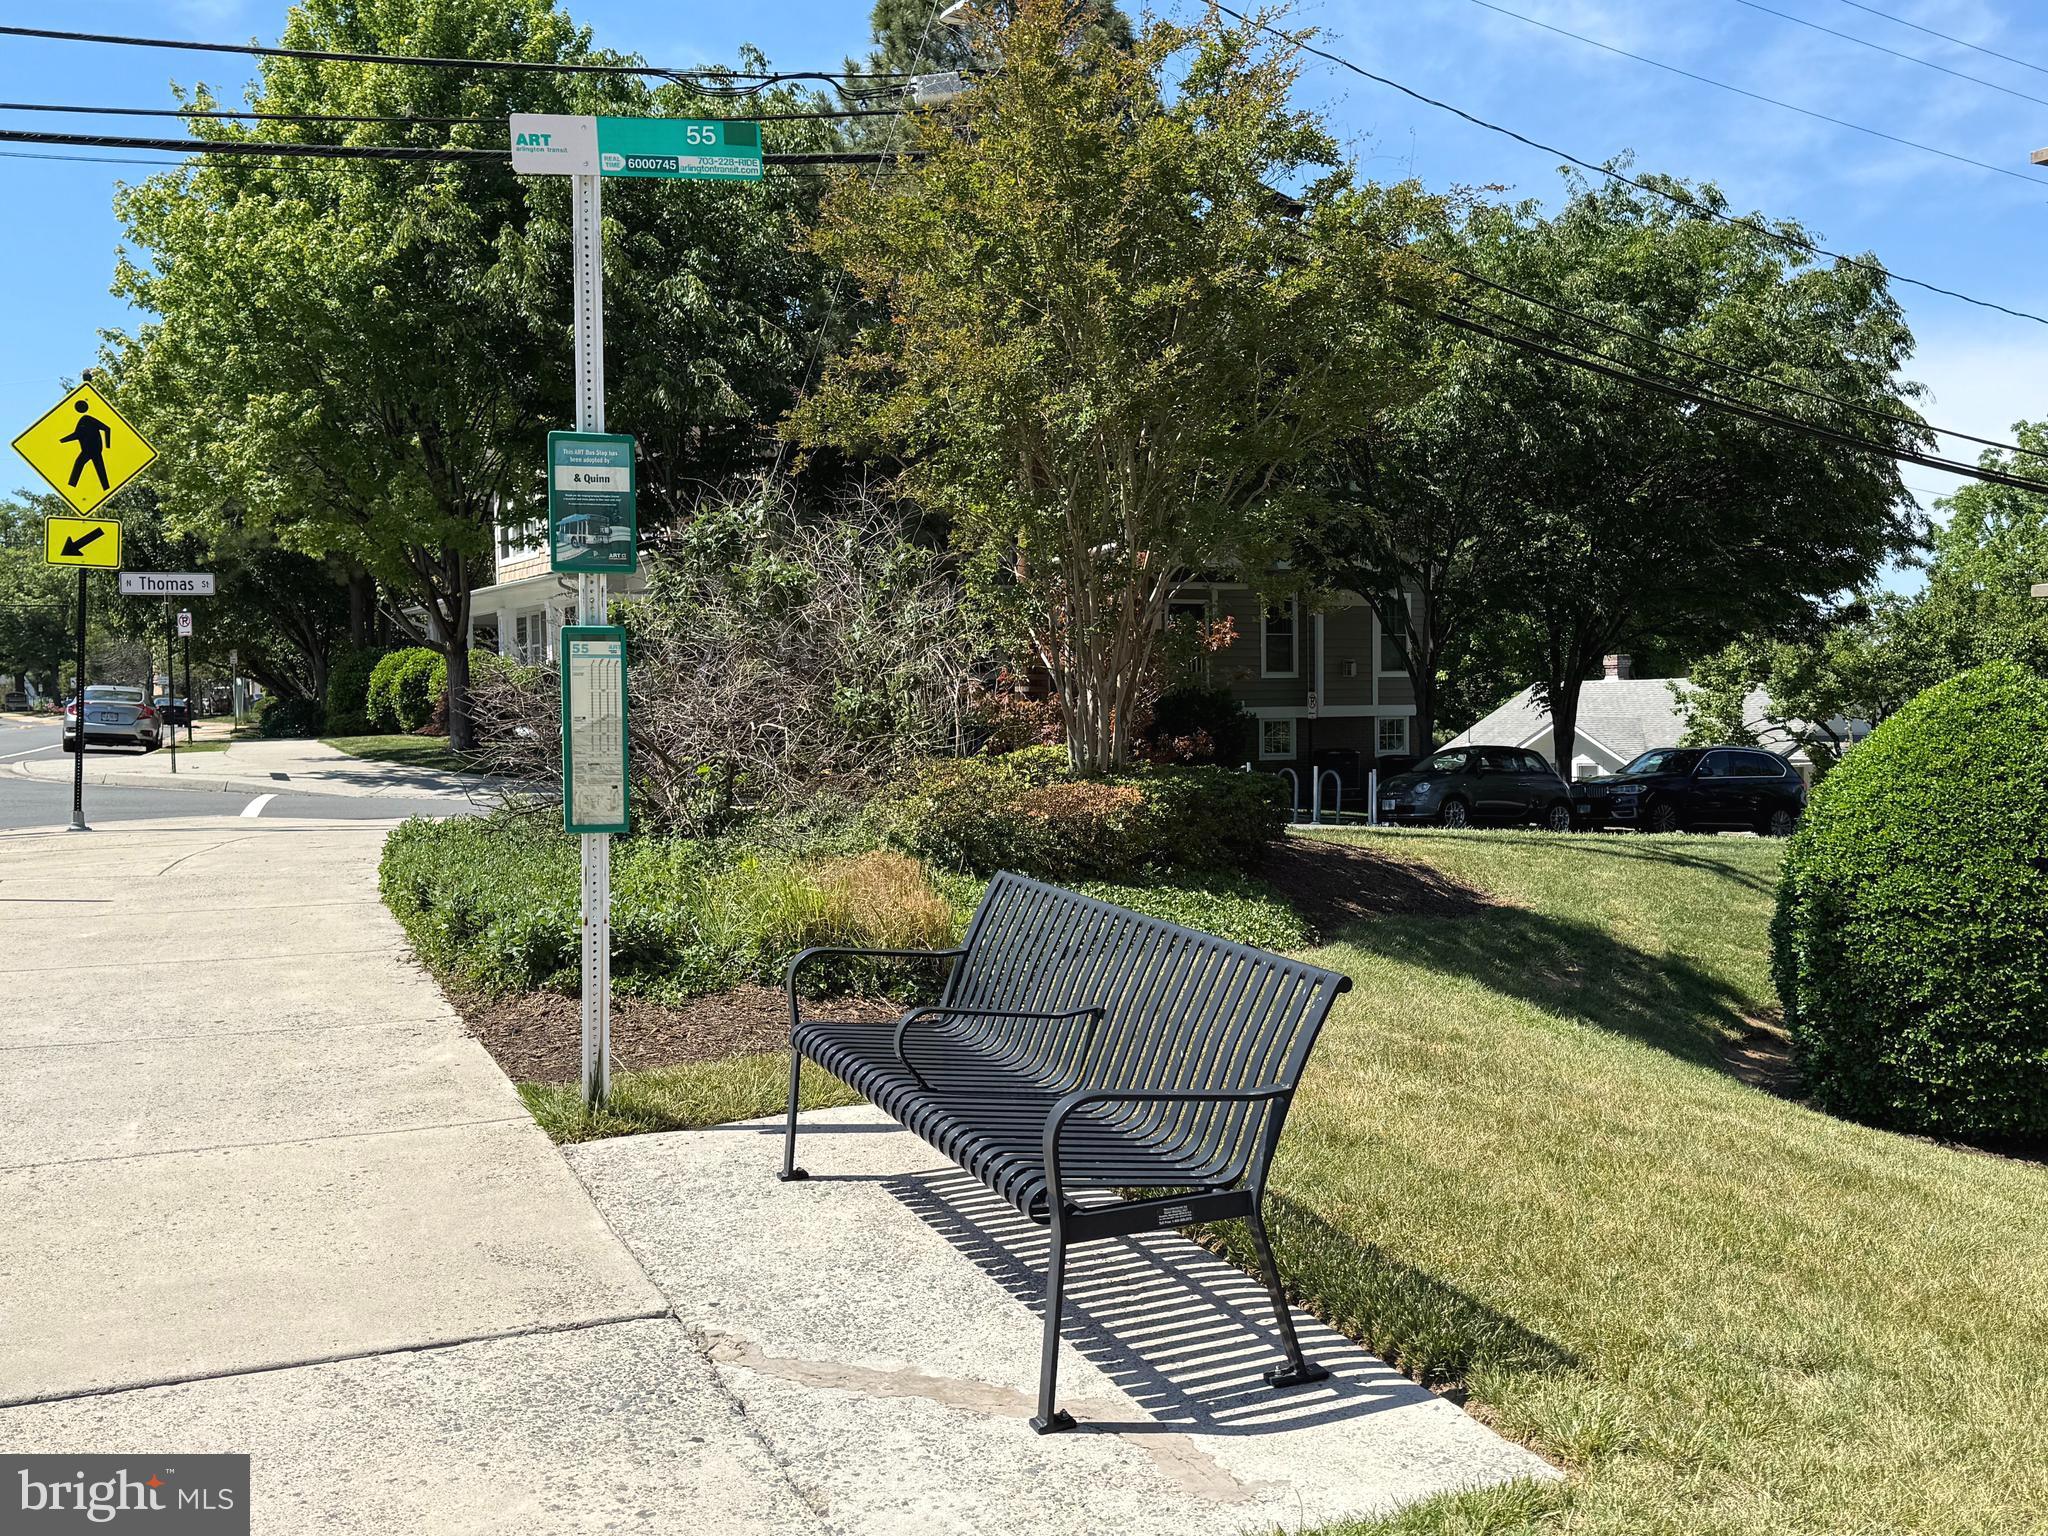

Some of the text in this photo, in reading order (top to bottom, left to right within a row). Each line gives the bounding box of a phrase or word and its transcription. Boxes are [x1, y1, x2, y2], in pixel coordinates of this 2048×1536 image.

[516, 132, 552, 146] ART
[686, 125, 717, 145] 55
[628, 158, 677, 170] 6000745
[698, 157, 758, 167] 703-228-RIDE
[680, 164, 759, 174] arlingtontransit.com
[574, 473, 610, 484] & Quinn
[126, 576, 209, 591] N Thomas St
[572, 643, 589, 653] 55
